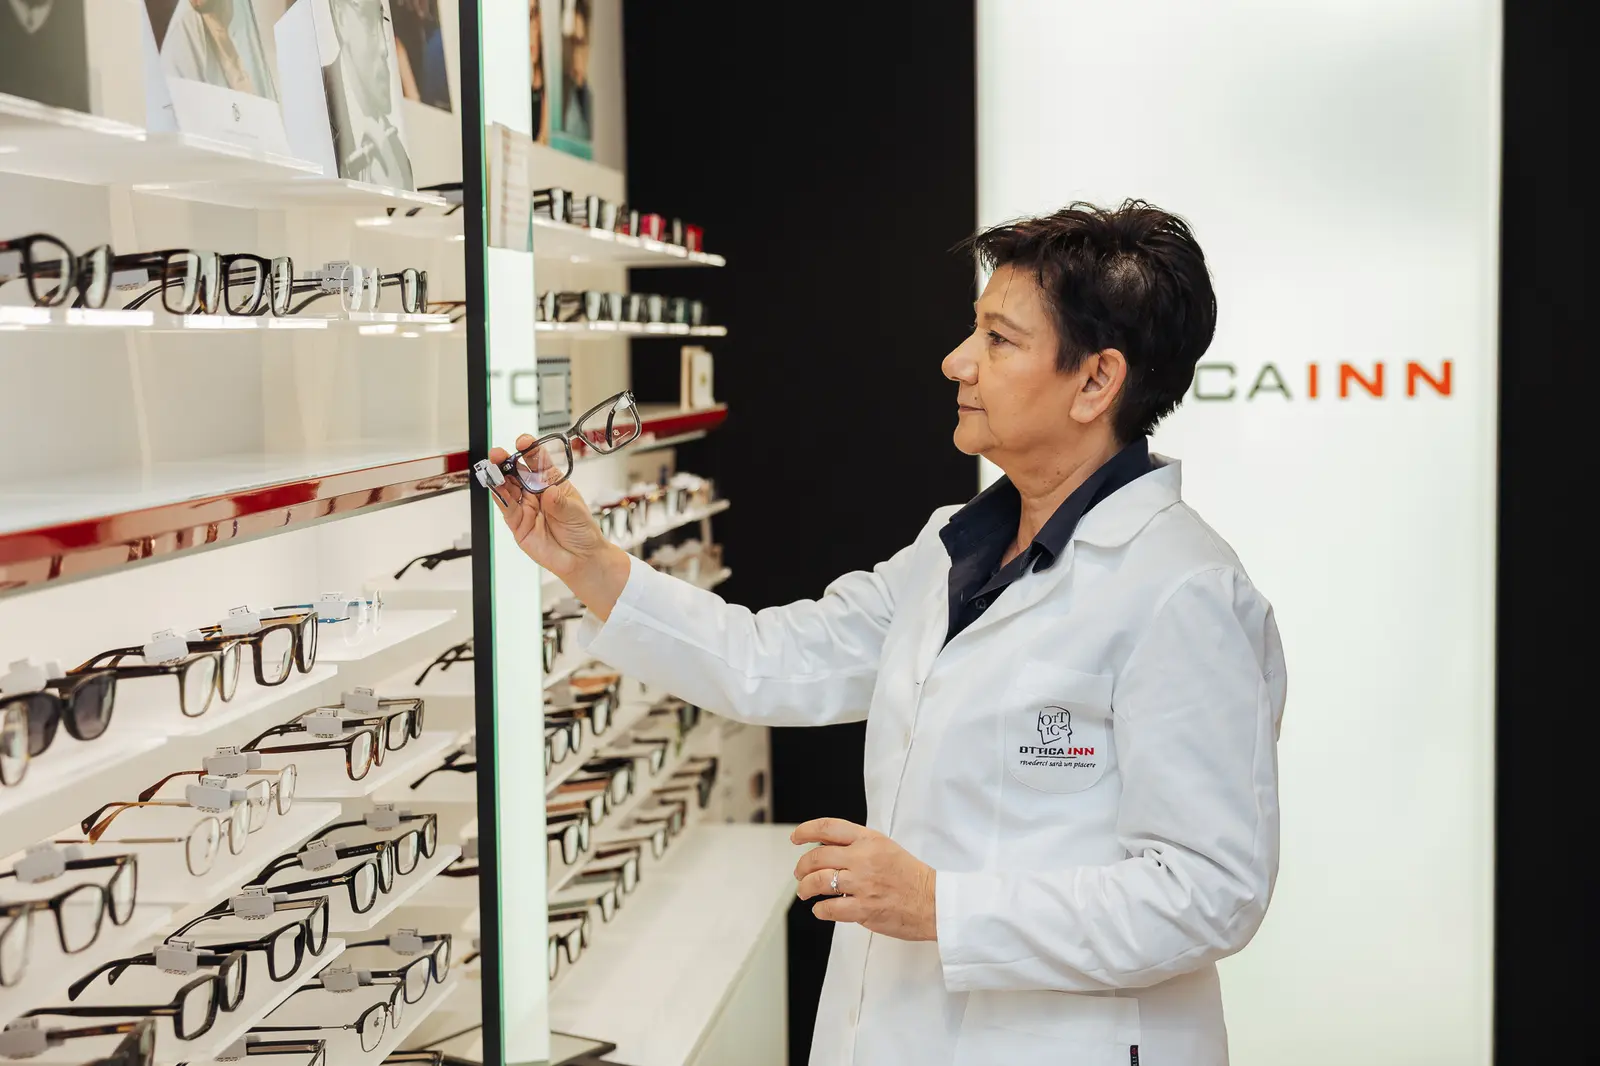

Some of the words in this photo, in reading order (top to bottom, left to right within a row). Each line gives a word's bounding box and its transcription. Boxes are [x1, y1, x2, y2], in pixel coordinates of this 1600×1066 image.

[1192, 361, 1293, 402] CA
[1019, 746, 1065, 755] OTTICA
[1067, 747, 1095, 756] INN
